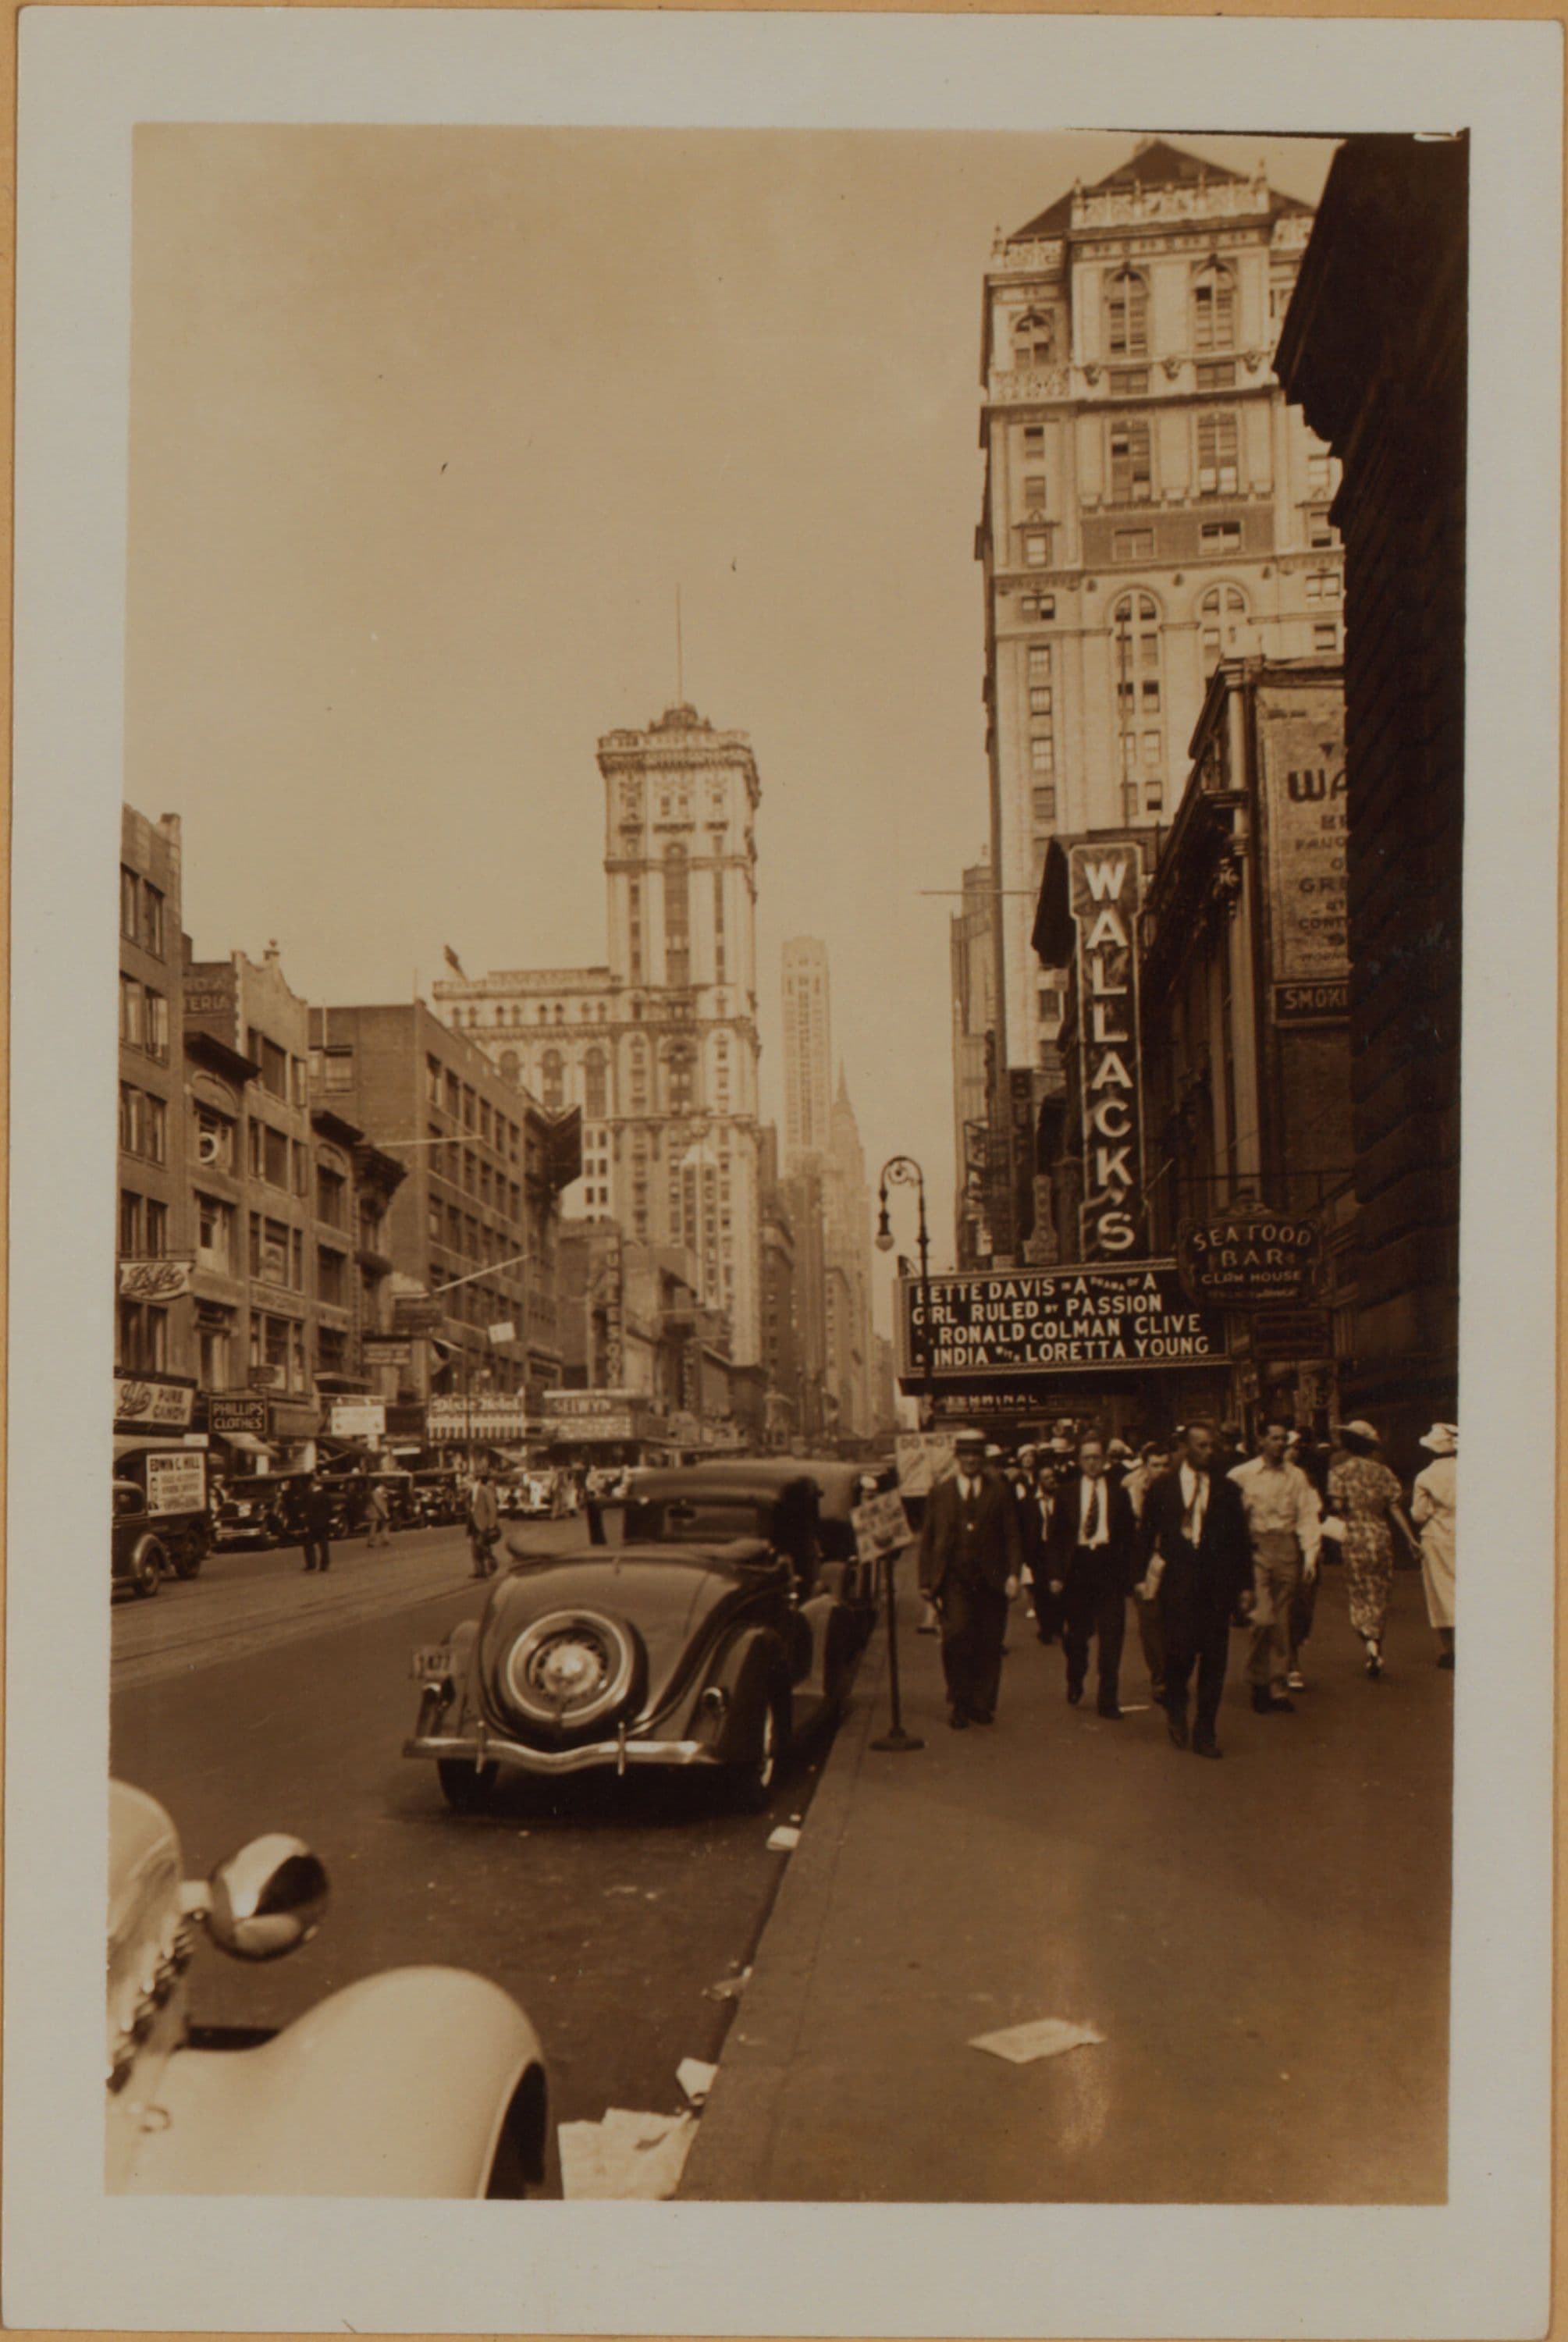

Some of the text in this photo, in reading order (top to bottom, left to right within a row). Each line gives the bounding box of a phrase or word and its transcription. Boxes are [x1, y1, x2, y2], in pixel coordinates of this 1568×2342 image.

[1083, 862, 1136, 1250] WALLACK'S
[1193, 1223, 1312, 1252] SEA FOOD
[1221, 1248, 1284, 1267] BAR
[988, 1278, 1055, 1300] DAVIS
[1073, 1275, 1088, 1295] A
[1142, 1272, 1157, 1291] A
[1250, 1270, 1302, 1283] HOUSE
[912, 1305, 958, 1326] GRL
[970, 1300, 1039, 1323] RULED
[1065, 1293, 1162, 1318] PASSION
[939, 1322, 1026, 1345] RONALD
[1031, 1317, 1121, 1340] COLMAN
[1134, 1313, 1201, 1335] CLIVE
[933, 1345, 990, 1367] INDIA
[1025, 1340, 1126, 1363] LORETTA
[1134, 1335, 1209, 1357] YOUNG
[158, 1389, 183, 1404] PURE
[152, 1404, 186, 1419] CANDY
[213, 1402, 264, 1416] PHILLIPS
[213, 1416, 263, 1430] CLOTHES
